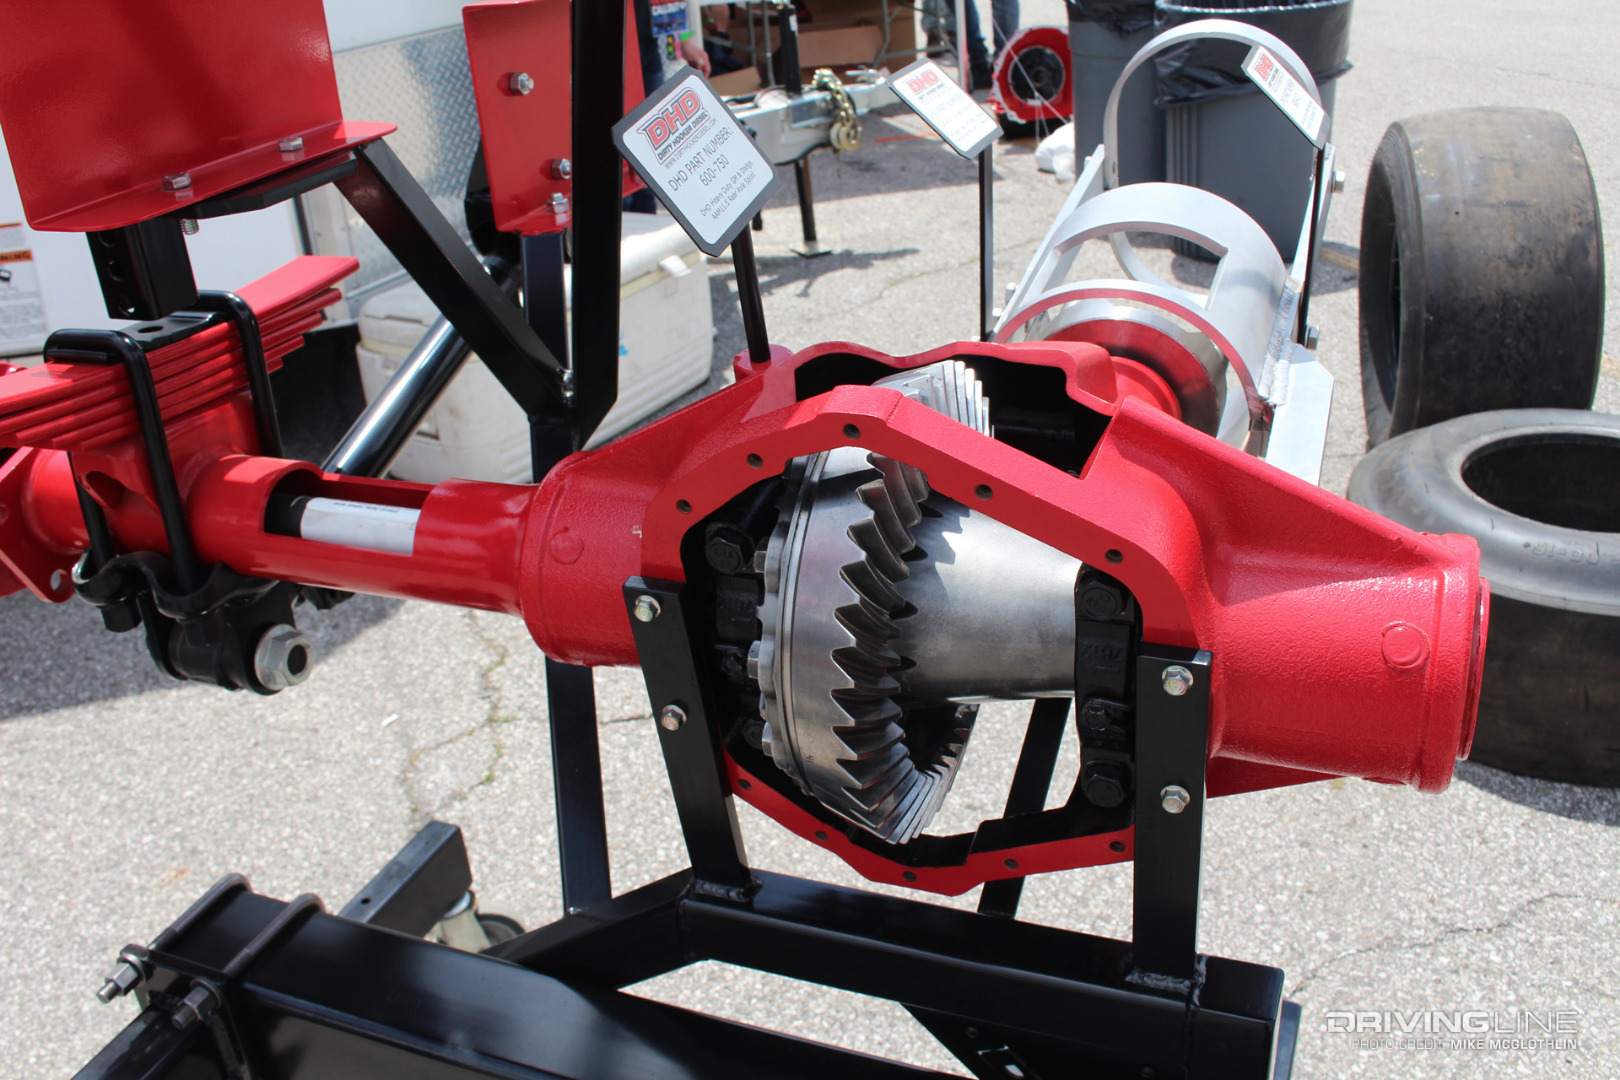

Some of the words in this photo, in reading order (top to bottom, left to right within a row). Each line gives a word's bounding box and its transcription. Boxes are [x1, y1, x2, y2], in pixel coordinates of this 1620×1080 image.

[906, 70, 938, 94] DHD
[1255, 53, 1273, 81] DHD
[645, 89, 700, 150] DHD
[657, 142, 673, 160] DIRTY
[673, 124, 694, 147] HOOKER
[691, 111, 708, 128] DIESEL
[665, 118, 717, 169] WWW.DIRTYHOOKERDIESEL.COM
[668, 170, 688, 191] DHD
[685, 151, 704, 174] PART
[702, 126, 734, 155] NUMBER:
[699, 154, 729, 187] 600-750
[700, 203, 711, 217] DHD
[711, 191, 723, 208] Heavy
[721, 181, 732, 195] Duty
[730, 173, 739, 183] GM
[739, 160, 753, 175] Dodge
[728, 188, 738, 202] Rear
[736, 181, 746, 194] Axle
[744, 172, 756, 187] Spool
